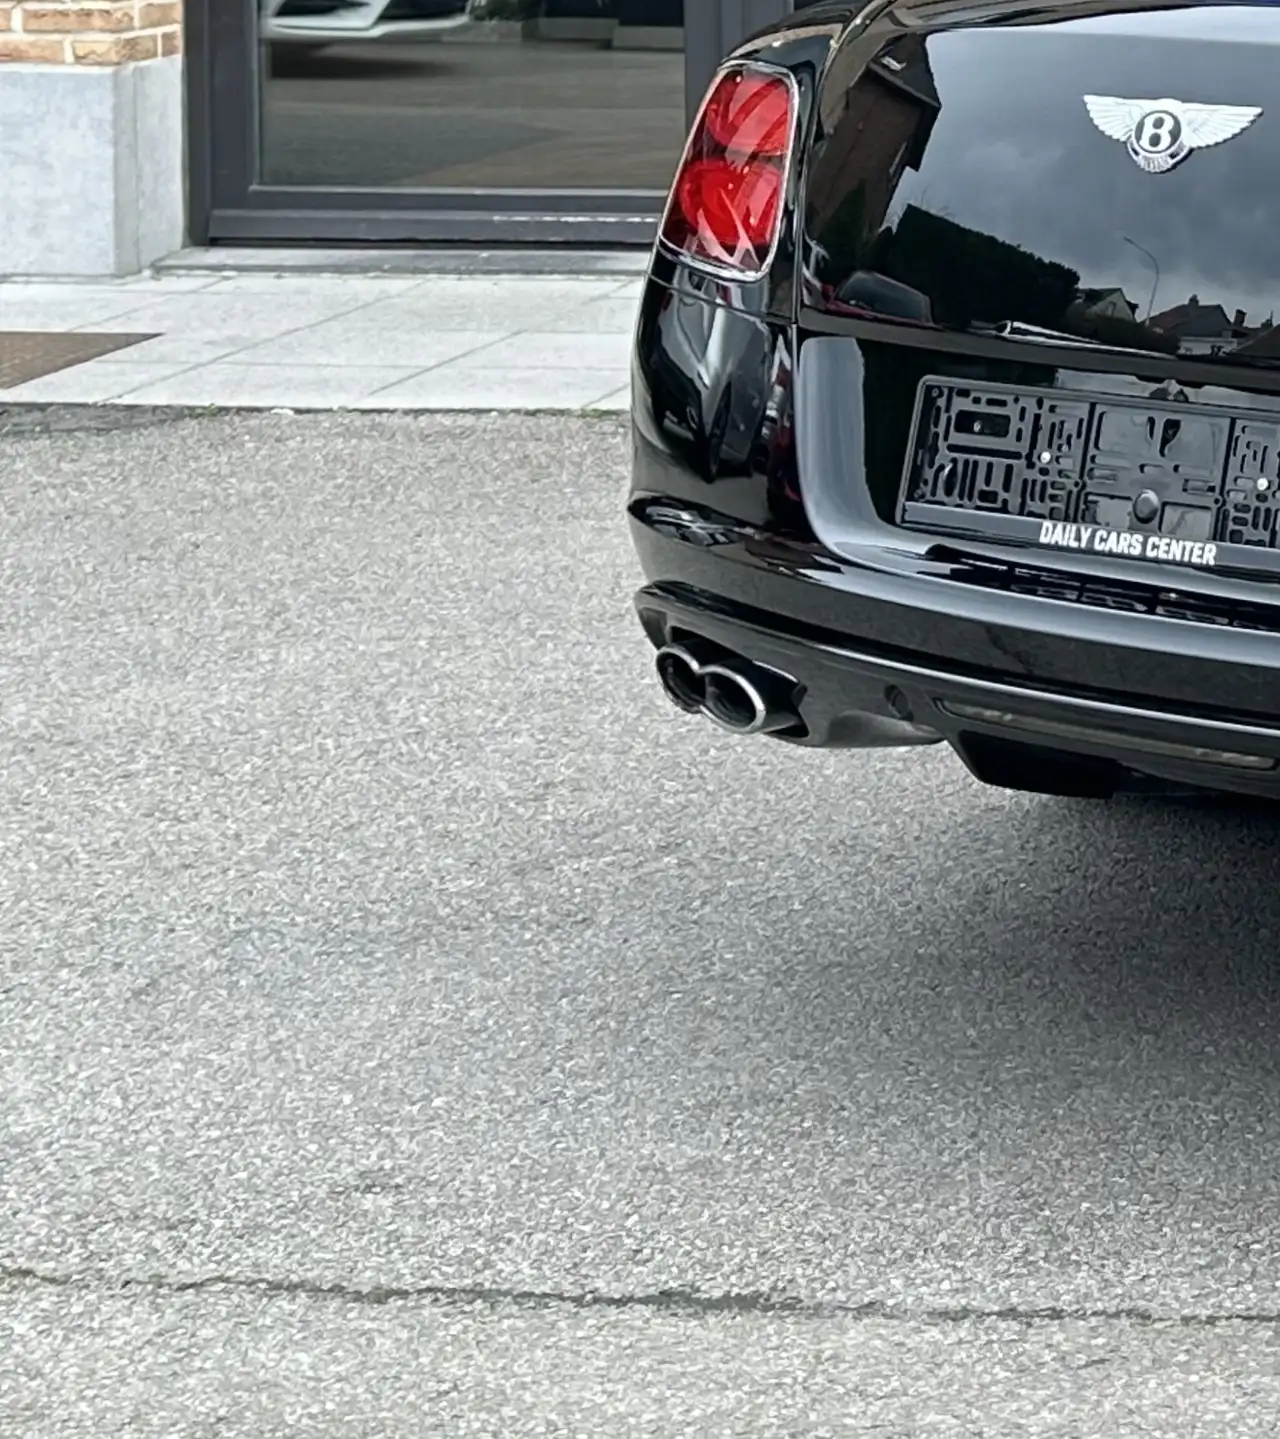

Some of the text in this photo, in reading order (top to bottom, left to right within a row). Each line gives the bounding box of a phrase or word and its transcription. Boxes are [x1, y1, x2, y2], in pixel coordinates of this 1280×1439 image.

[1039, 521, 1217, 566] DAILY CARS CENTER
